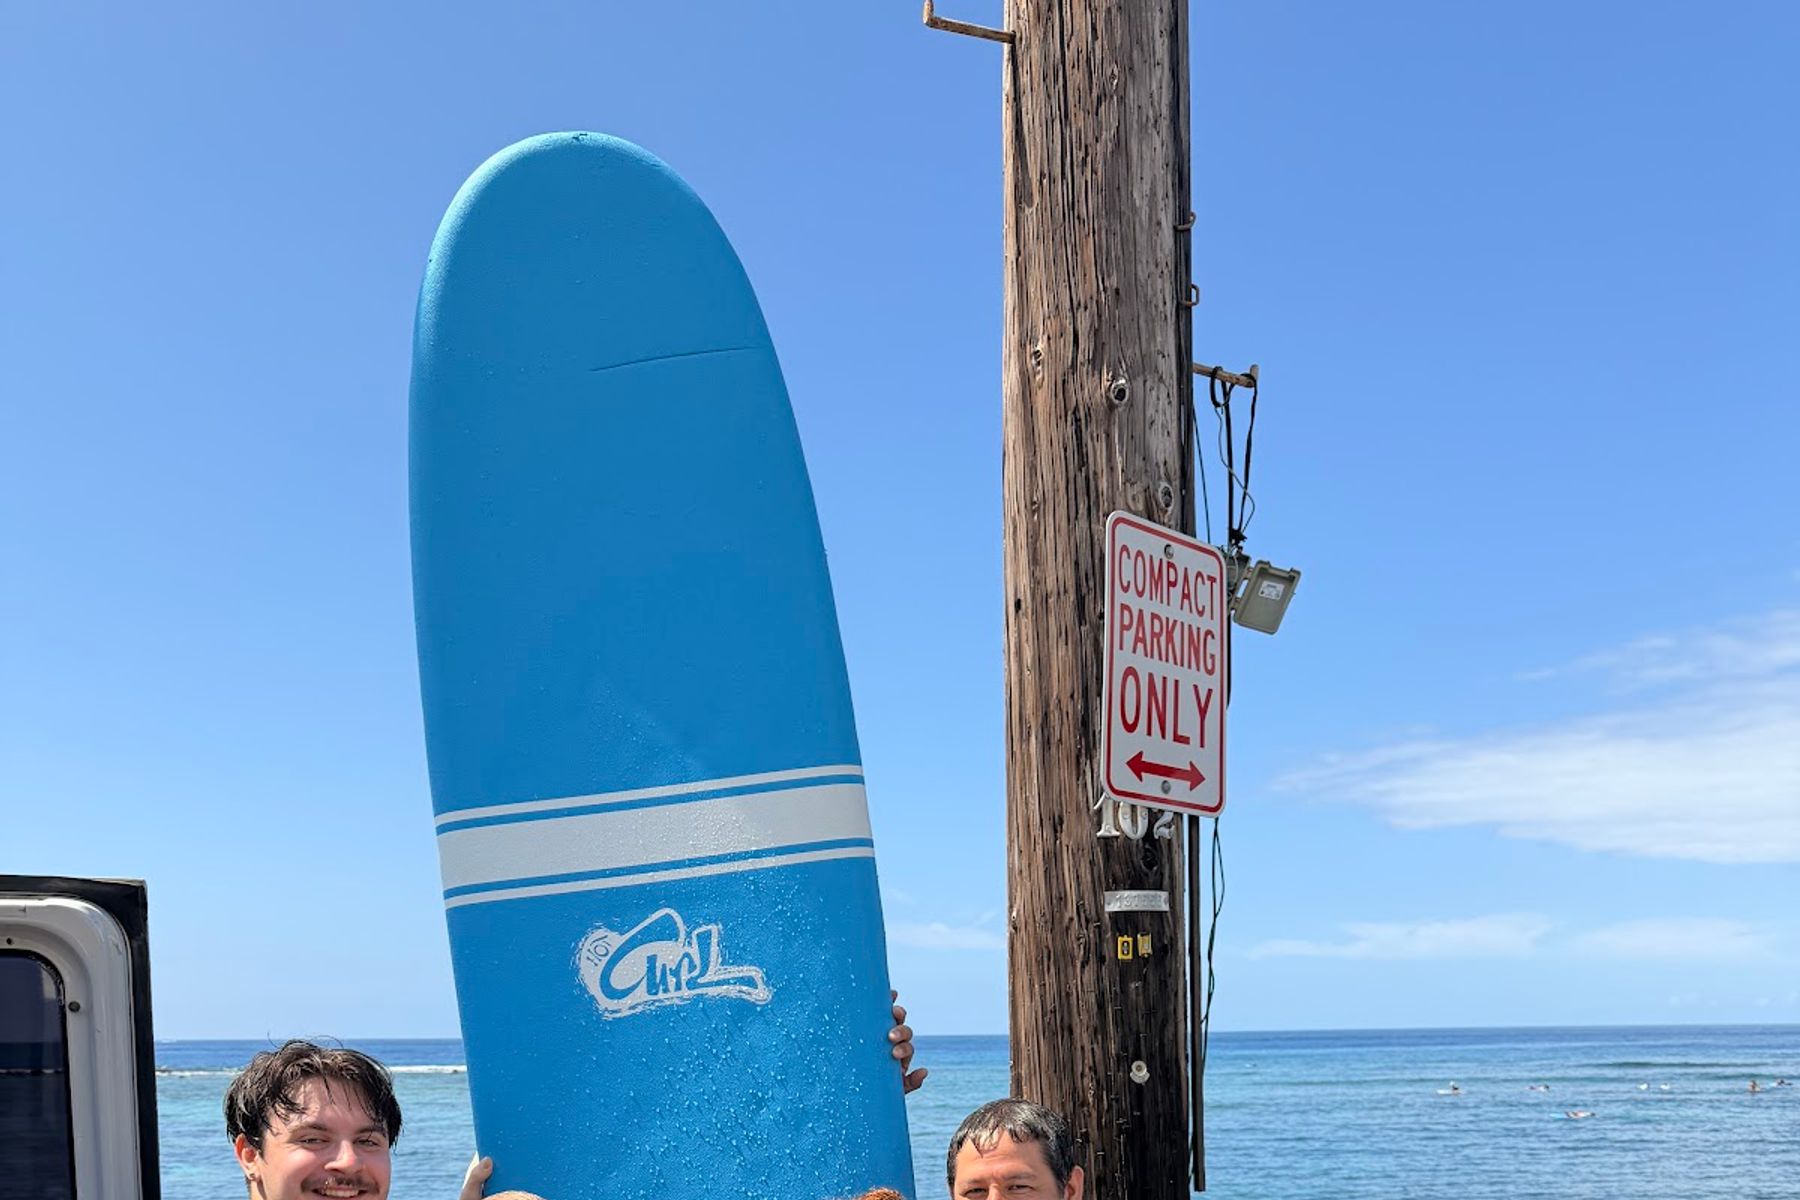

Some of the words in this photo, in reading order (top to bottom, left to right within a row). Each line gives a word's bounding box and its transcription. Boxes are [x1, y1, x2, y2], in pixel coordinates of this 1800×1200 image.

[1119, 544, 1217, 620] COMPACT
[1119, 603, 1216, 676] PARKING
[1120, 666, 1213, 748] ONLY
